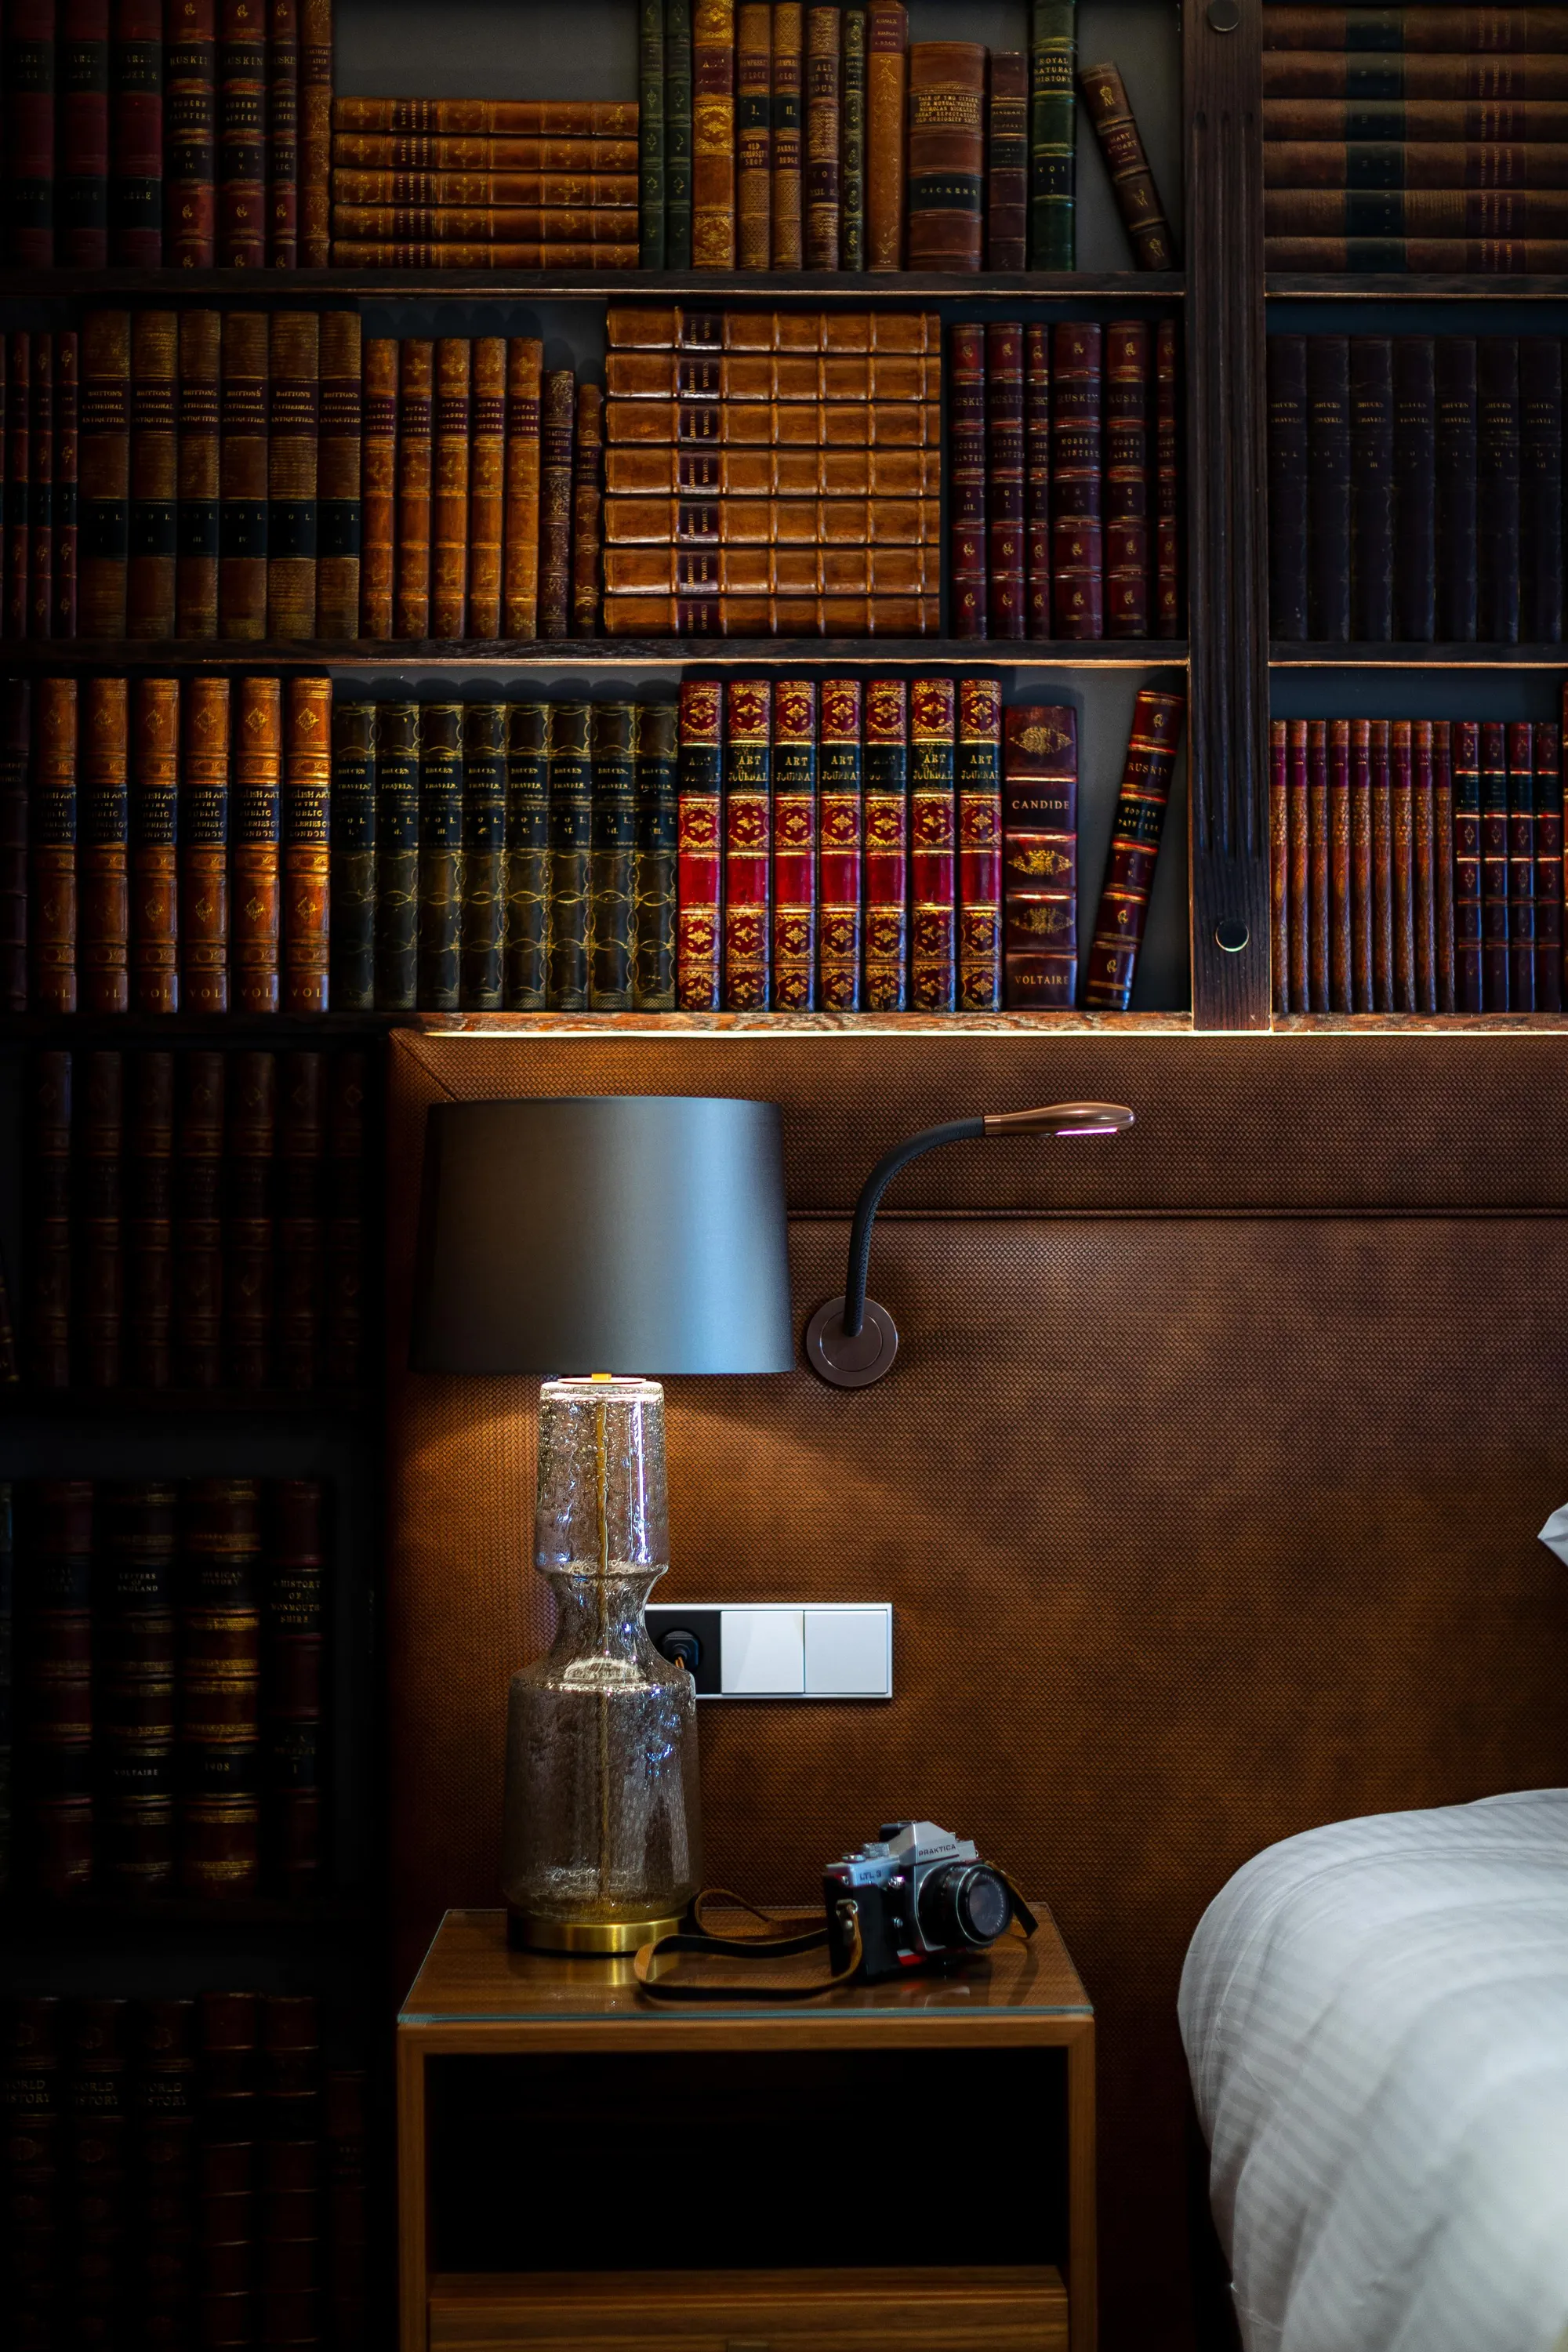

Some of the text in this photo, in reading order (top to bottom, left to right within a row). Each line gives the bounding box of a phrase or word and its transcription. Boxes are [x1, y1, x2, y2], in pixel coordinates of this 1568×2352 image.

[815, 63, 832, 72] ALL
[920, 187, 978, 196] DICKENS
[700, 555, 709, 582] WORKS
[738, 756, 761, 765] ART
[785, 757, 808, 766] ART
[831, 755, 854, 765] ART
[923, 754, 947, 764] ART
[970, 755, 993, 764] ART
[264, 789, 280, 799] ART
[315, 789, 332, 800] ART
[1011, 800, 1070, 810] CANDIDE
[1123, 806, 1158, 819] MODERN
[1014, 975, 1069, 985] VOLTAIRE
[281, 1580, 321, 1589] HISTORY
[205, 1762, 231, 1772] 1908
[114, 1768, 158, 1777] VOLTAIRE
[918, 1843, 956, 1857] PRAKTICA
[859, 1871, 874, 1881] LTL
